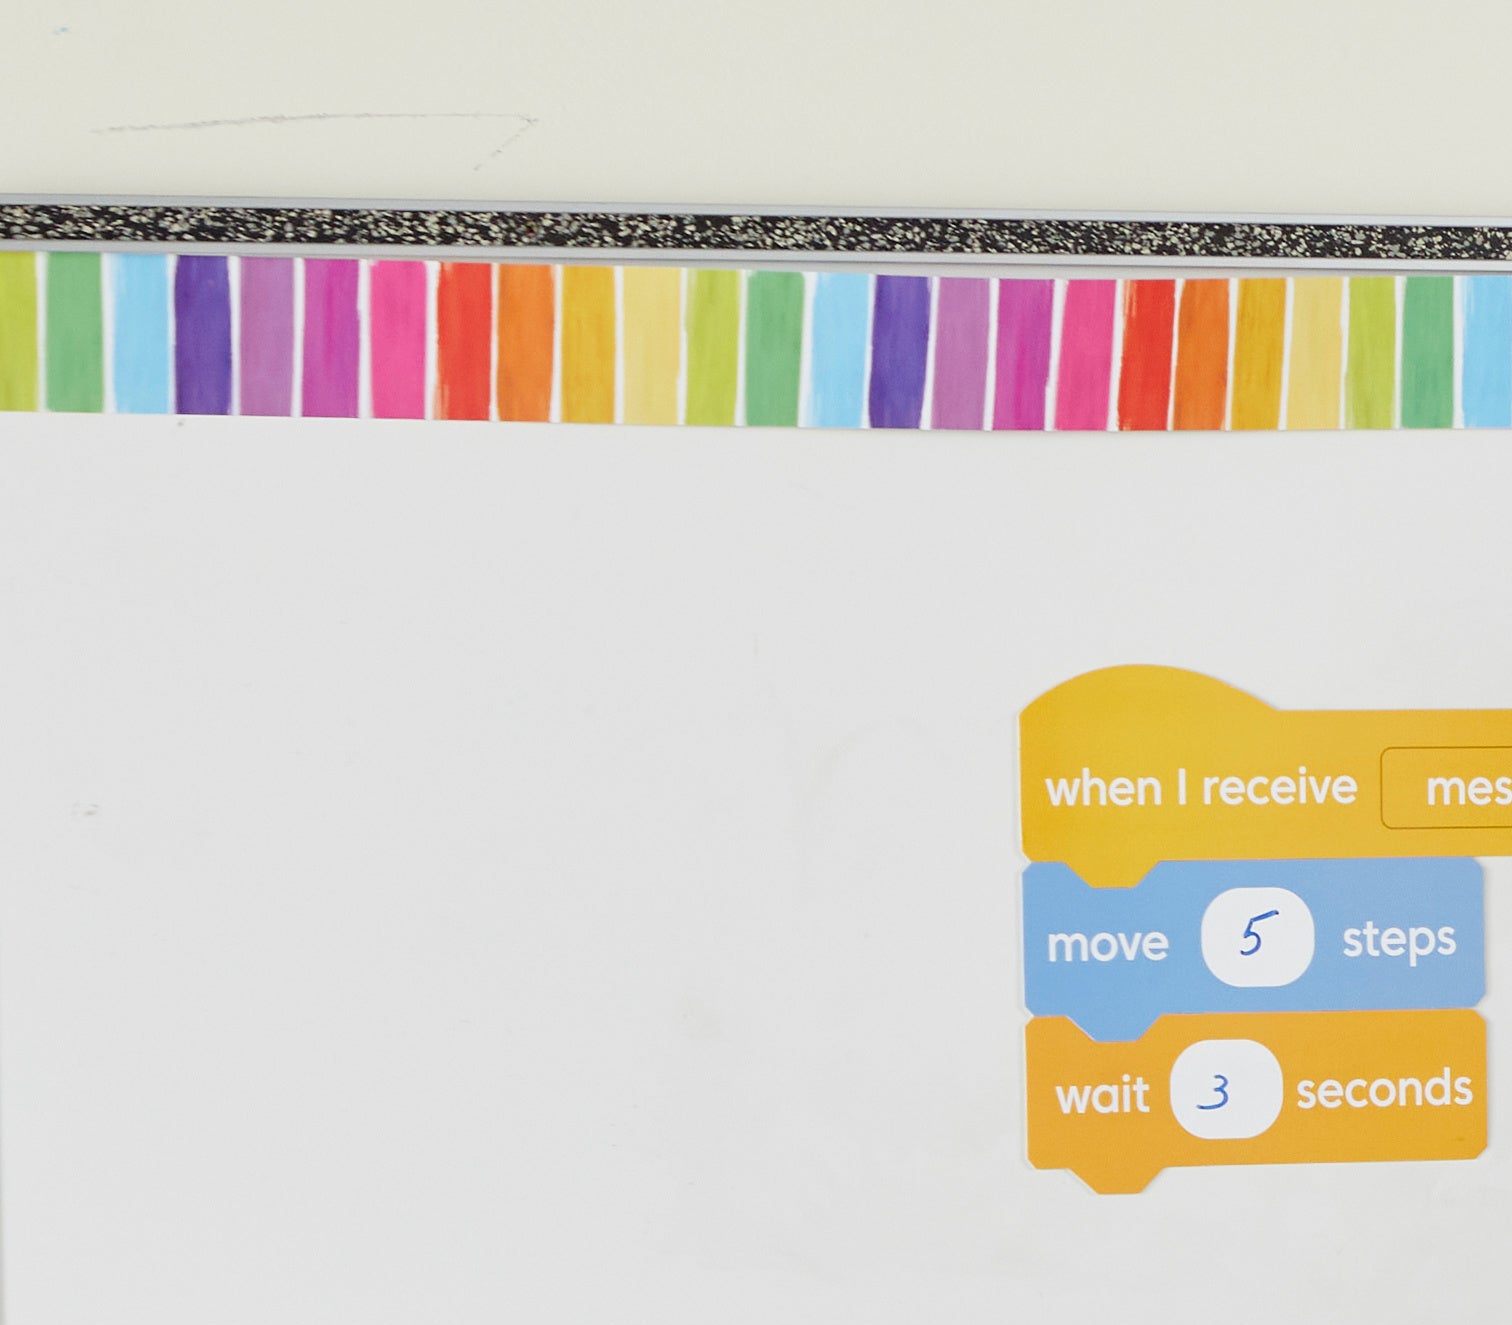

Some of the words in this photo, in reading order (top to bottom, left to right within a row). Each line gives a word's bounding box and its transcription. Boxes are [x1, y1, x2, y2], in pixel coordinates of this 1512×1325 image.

[1045, 767, 1162, 807] when
[1203, 766, 1358, 806] receive
[1047, 931, 1170, 963] move
[1240, 909, 1279, 956] 5
[1343, 920, 1457, 967] steps
[1055, 1074, 1151, 1115] wait
[1196, 1074, 1229, 1111] 3
[1296, 1067, 1474, 1110] seconds
